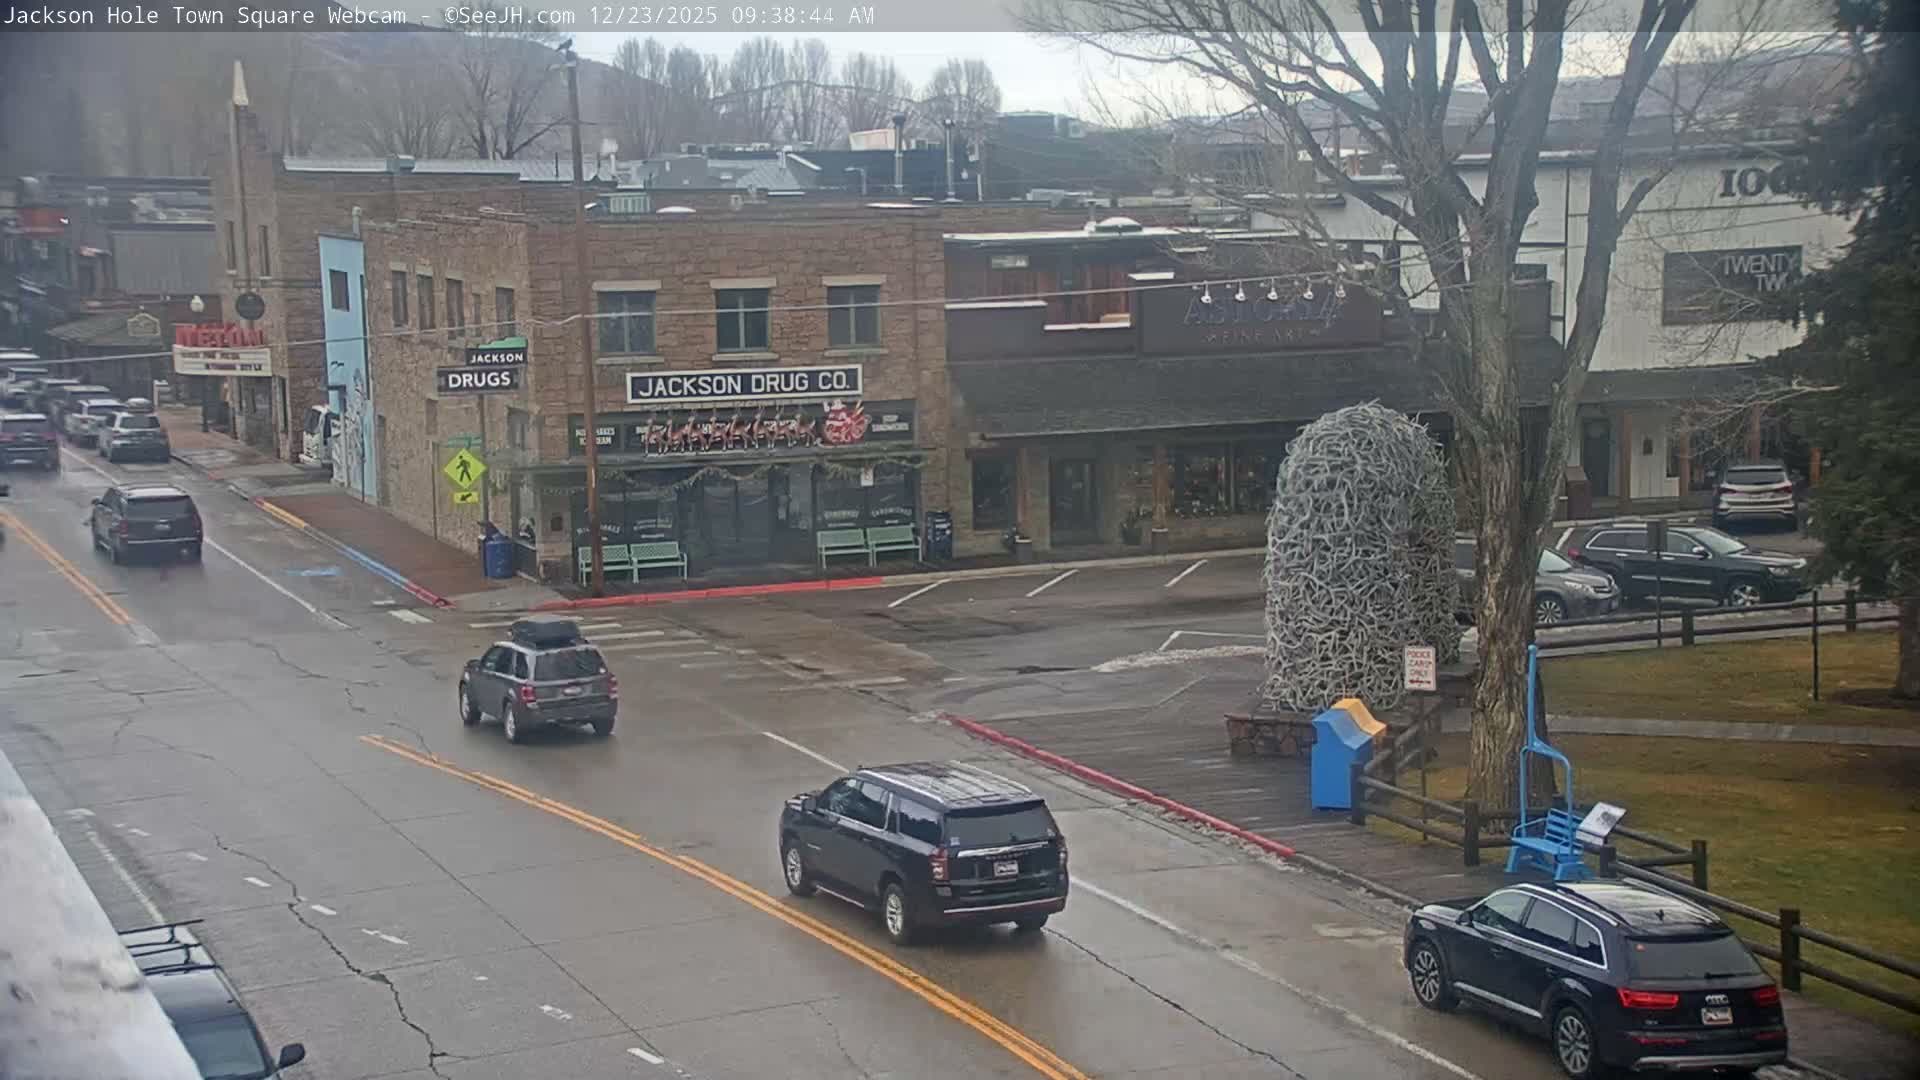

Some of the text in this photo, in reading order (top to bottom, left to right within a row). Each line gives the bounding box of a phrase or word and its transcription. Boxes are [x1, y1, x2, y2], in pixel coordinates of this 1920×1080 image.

[1723, 252, 1795, 275] TWENTY
[1756, 272, 1797, 293] TW
[471, 352, 524, 364] JACKSON
[448, 371, 511, 388] DRUGS
[639, 371, 850, 397] JACKSON DRUG CO.
[1407, 650, 1431, 658] POLICE
